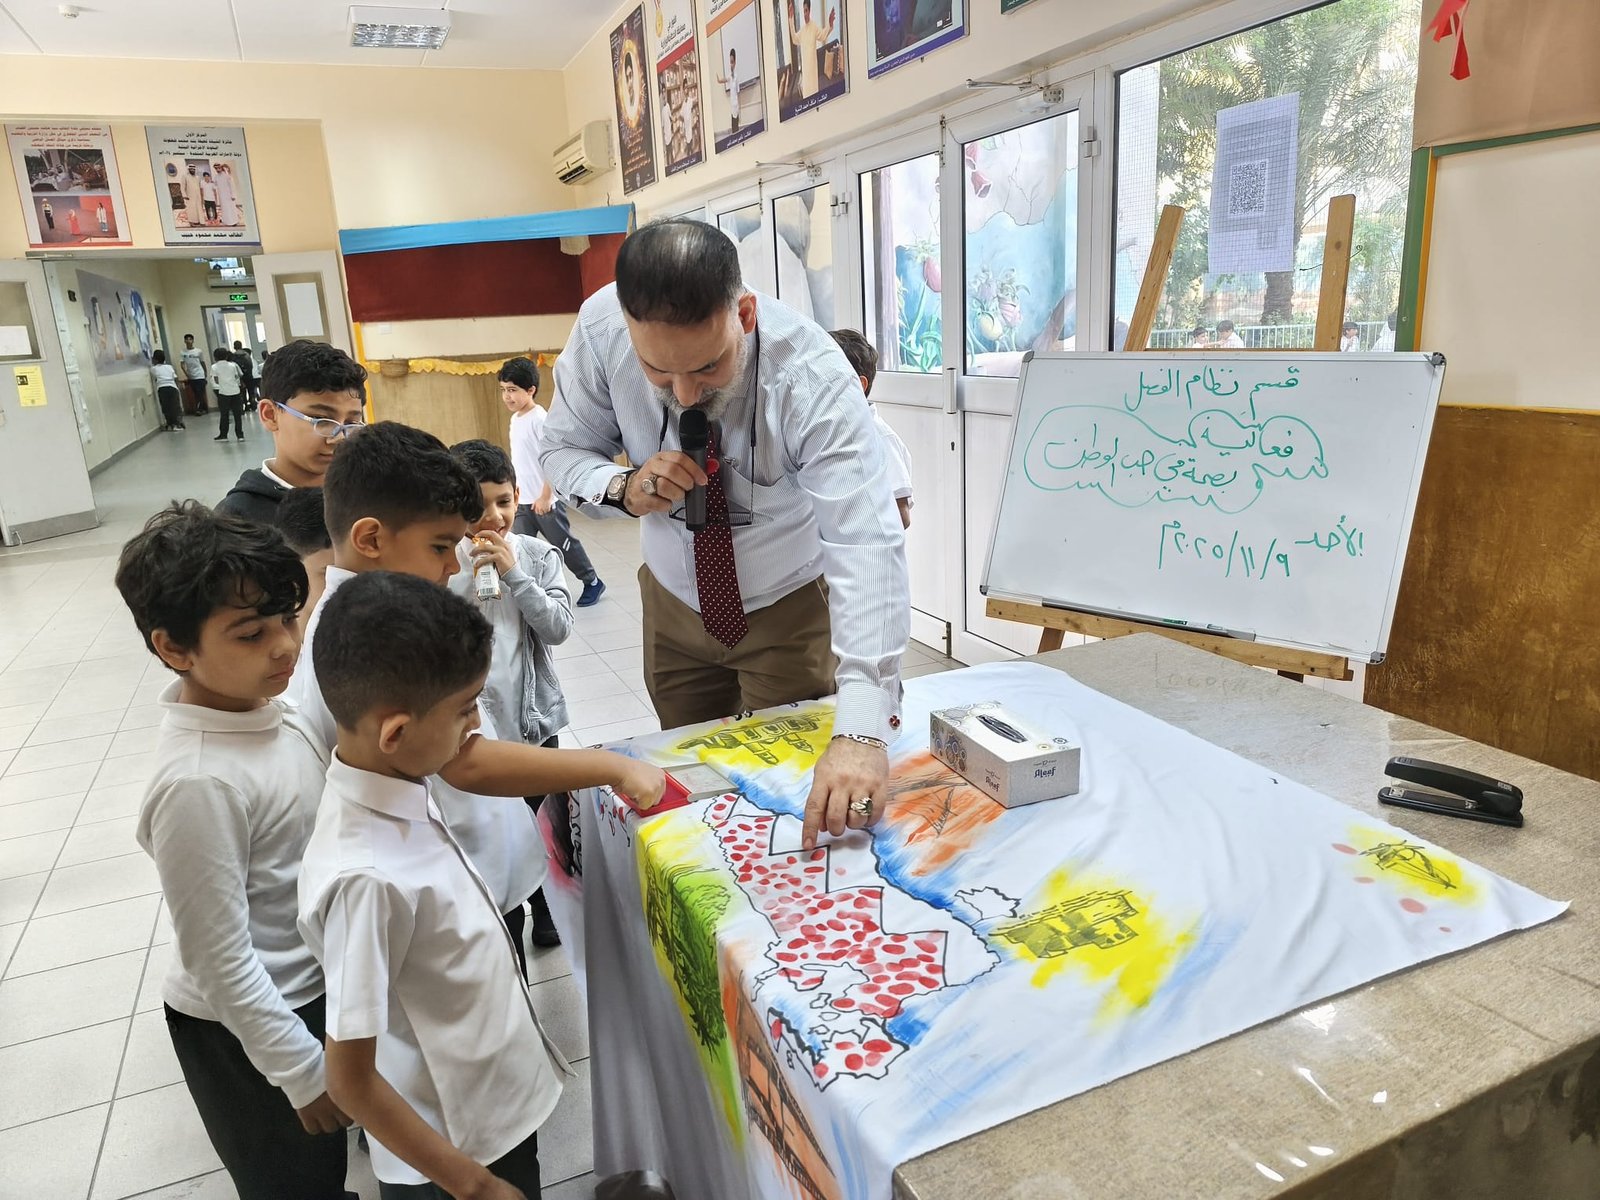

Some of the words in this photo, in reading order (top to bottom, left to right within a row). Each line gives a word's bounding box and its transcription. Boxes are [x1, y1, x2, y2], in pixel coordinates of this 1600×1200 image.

[1124, 368, 1180, 412] الفصل
[1185, 365, 1239, 409] نظام
[1249, 366, 1300, 421] قسم
[1044, 423, 1119, 487] الوطن
[1120, 449, 1155, 478] حب
